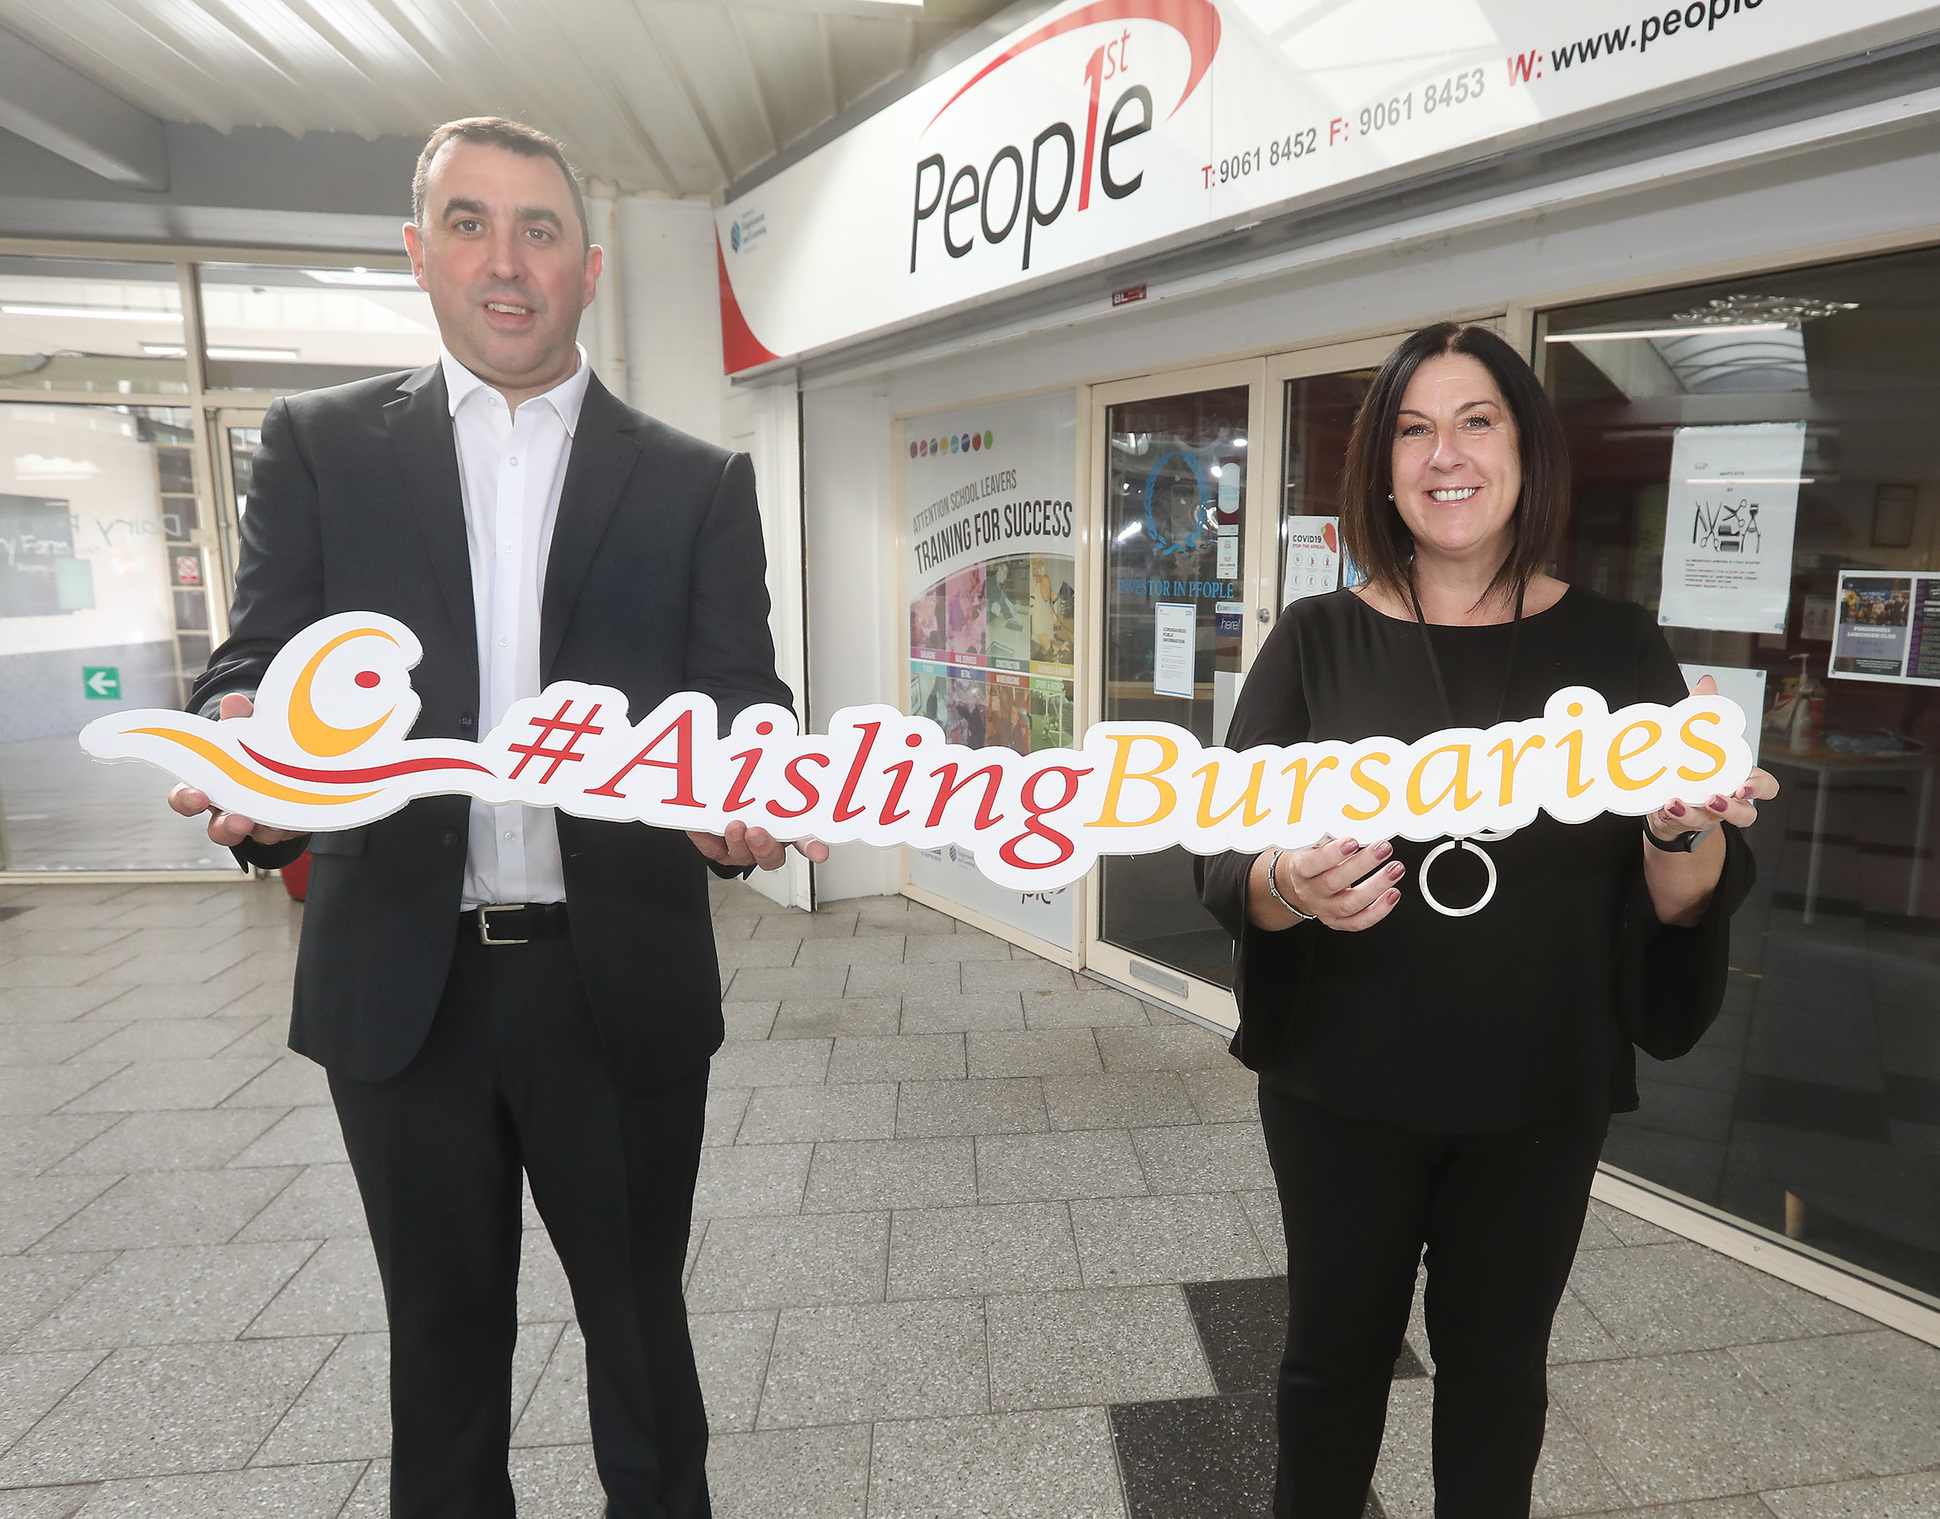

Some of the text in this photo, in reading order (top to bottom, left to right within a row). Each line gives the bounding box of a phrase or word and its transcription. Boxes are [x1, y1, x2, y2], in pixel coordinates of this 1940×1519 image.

[1201, 165, 1216, 189] T:
[1220, 147, 1261, 183] 9061
[1269, 128, 1317, 166] 8452
[1329, 117, 1349, 146] F:
[1359, 92, 1412, 135] 9061
[1424, 67, 1485, 114] 8453
[1507, 50, 1543, 87] W:
[912, 468, 1017, 535] ATTENTION SCHOOL LEAVERS
[914, 500, 1073, 574] TRAINING FOR SUCCESS
[1292, 534, 1322, 543] COVID19
[1117, 579, 1170, 596] INVESTOR
[1173, 580, 1186, 597] IN
[508, 699, 1727, 870] #AislingBursaries
